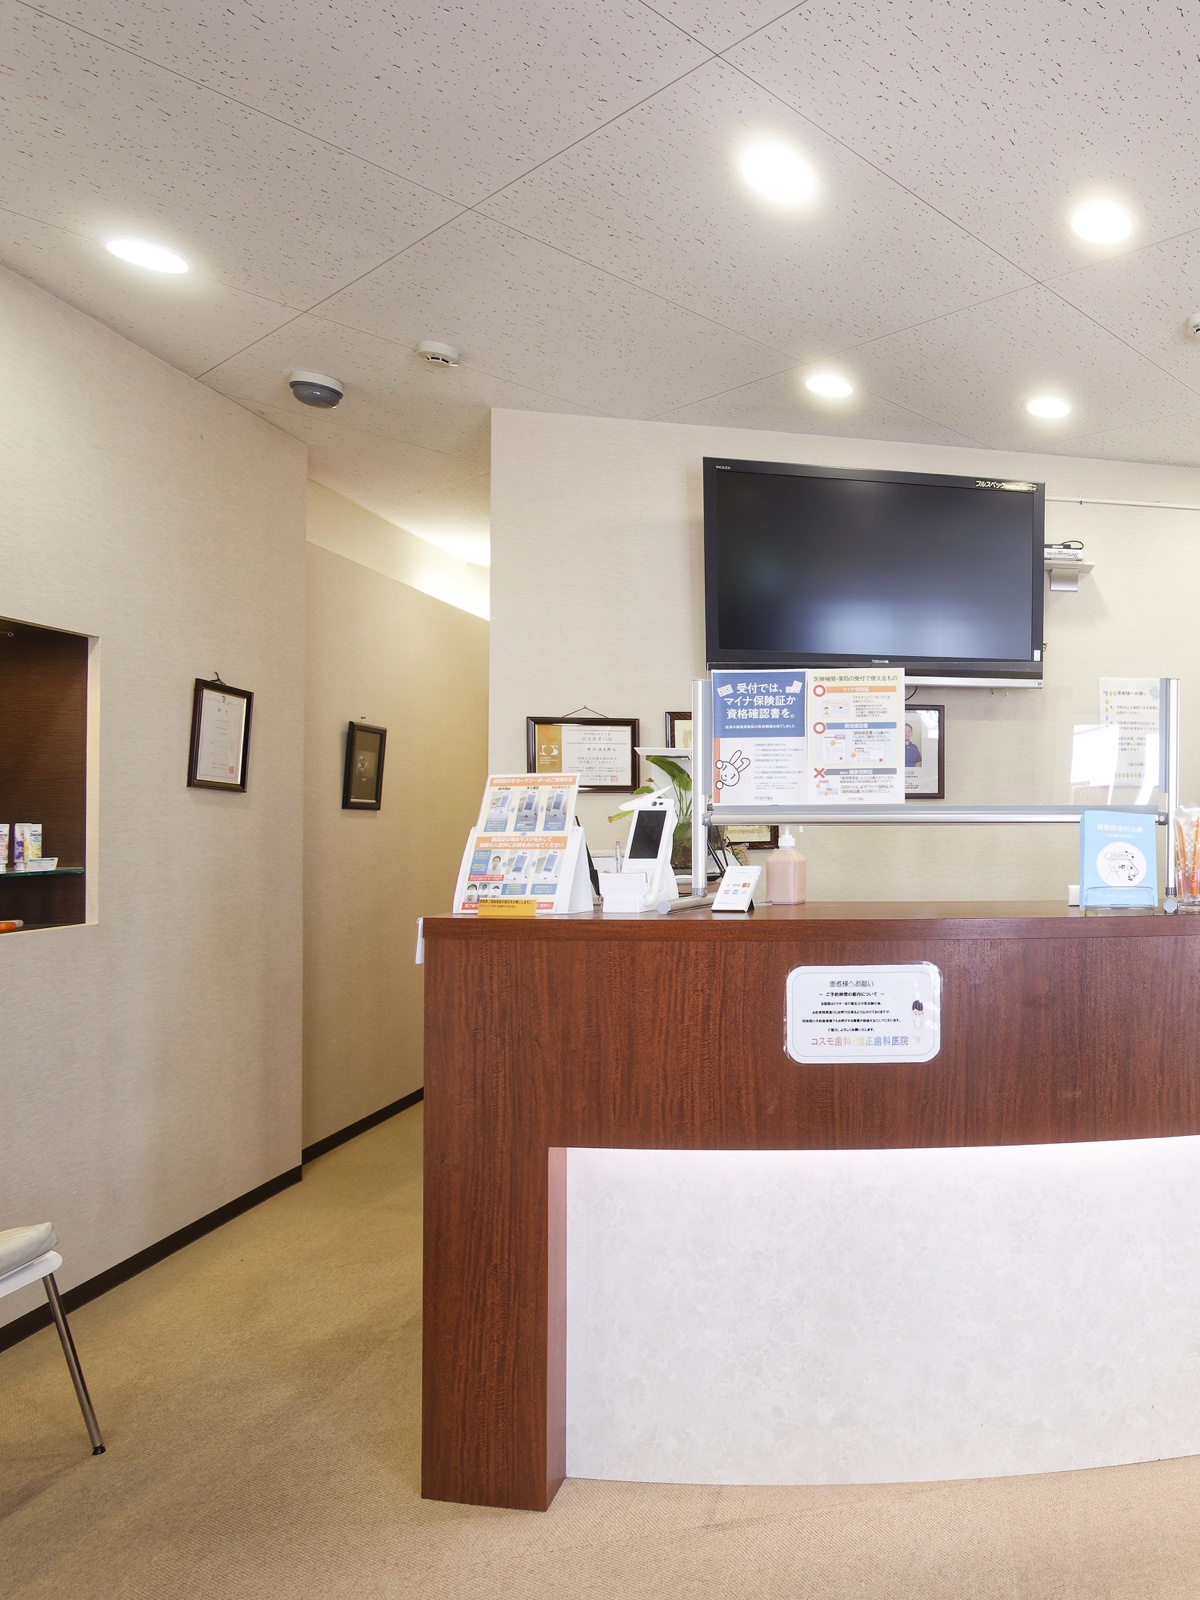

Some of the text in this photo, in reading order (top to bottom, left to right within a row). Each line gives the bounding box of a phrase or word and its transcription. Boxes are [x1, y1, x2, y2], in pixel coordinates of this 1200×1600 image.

[736, 683, 782, 694] 受付では、
[724, 696, 796, 706] マイナ保険証か
[726, 708, 795, 719] 資格確認書を。
[812, 1036, 909, 1046] コスモ歯科・矯正歯科医院
